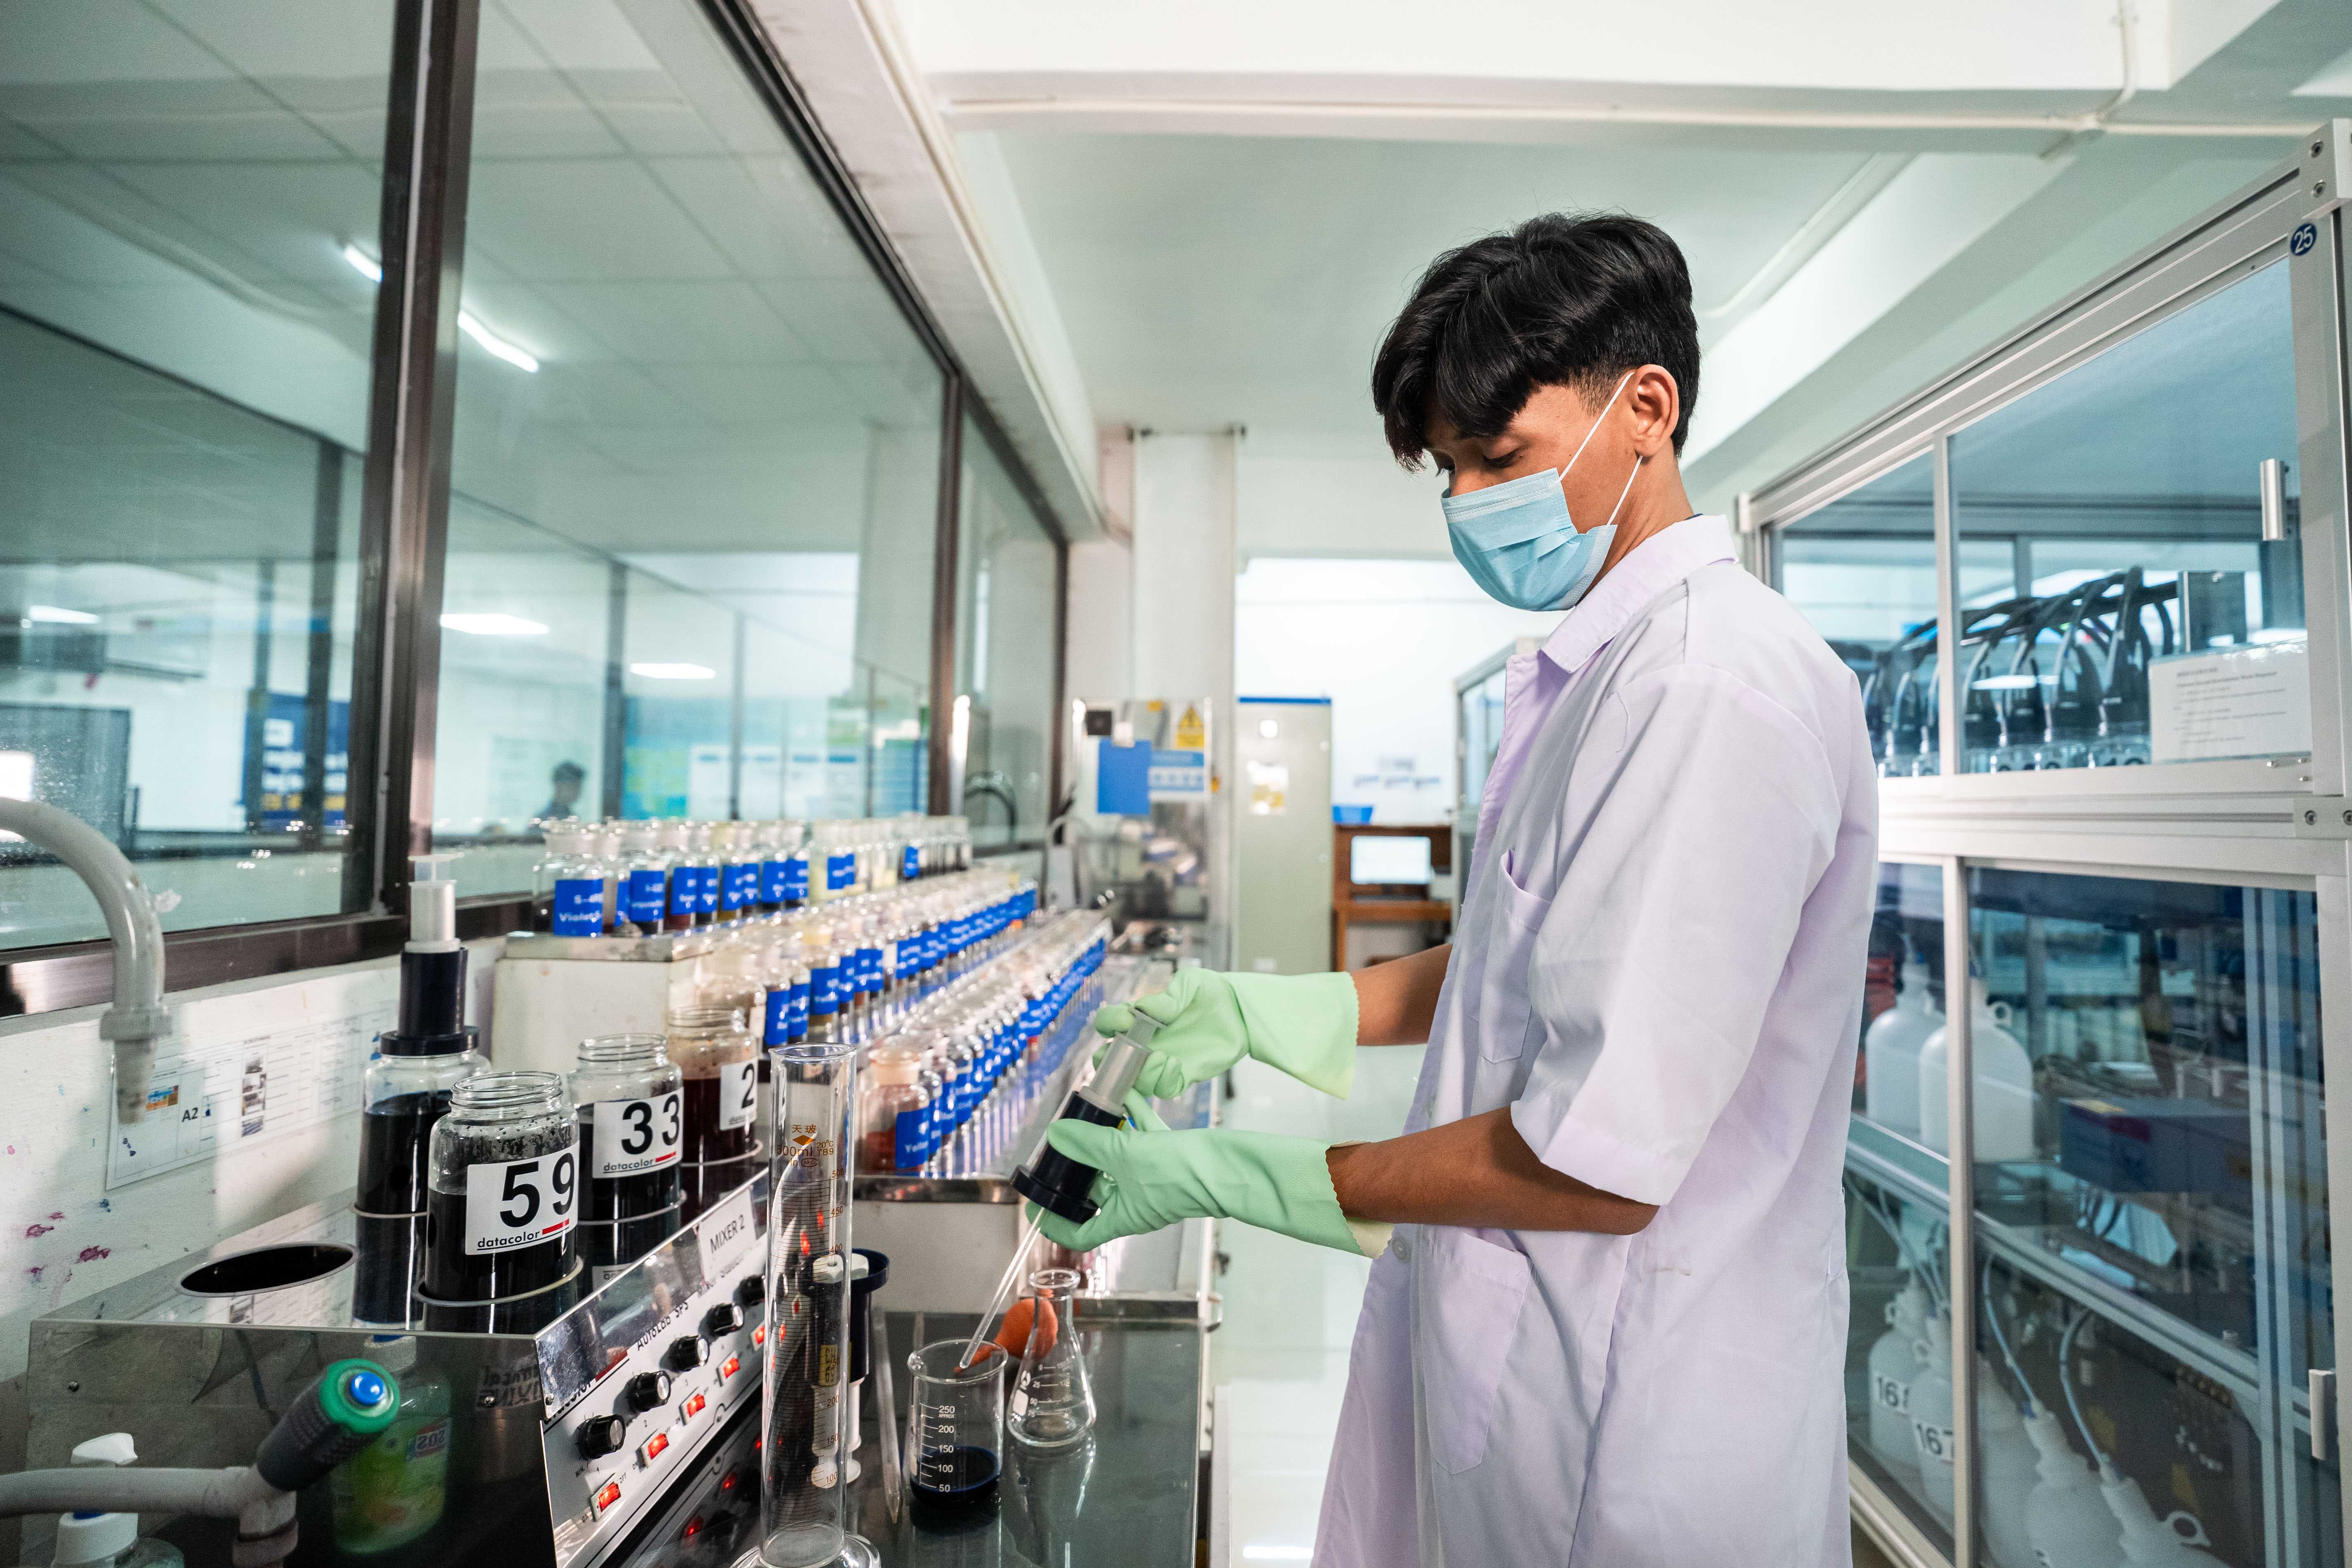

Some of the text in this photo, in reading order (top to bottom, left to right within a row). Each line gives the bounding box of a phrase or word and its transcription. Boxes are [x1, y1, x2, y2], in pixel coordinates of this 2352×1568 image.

[2293, 226, 2314, 254] 25
[182, 1107, 198, 1122] A2
[621, 1094, 679, 1155] 33
[777, 1144, 812, 1156] 500ml
[817, 1140, 833, 1149] 20°C
[817, 1148, 834, 1156] TB9
[603, 1159, 653, 1171] datacolor
[832, 1168, 844, 1178] 500
[500, 1153, 574, 1228] 59
[831, 1205, 843, 1216] 450
[478, 1231, 540, 1248] datacolor
[710, 1215, 745, 1253] MIXER 2
[830, 1243, 843, 1254] 400
[829, 1283, 842, 1292] 350
[828, 1319, 841, 1330] 300
[828, 1357, 840, 1370] 250
[827, 1395, 839, 1407] 200
[939, 1405, 955, 1414] 250
[644, 1420, 647, 1428] 2
[938, 1425, 954, 1433] 200
[826, 1433, 838, 1445] 150
[939, 1445, 954, 1453] 150
[575, 1466, 585, 1478] MIN.
[938, 1464, 954, 1473] 100
[826, 1471, 837, 1483] 100
[939, 1484, 951, 1493] 50
[829, 1510, 836, 1521] 50
